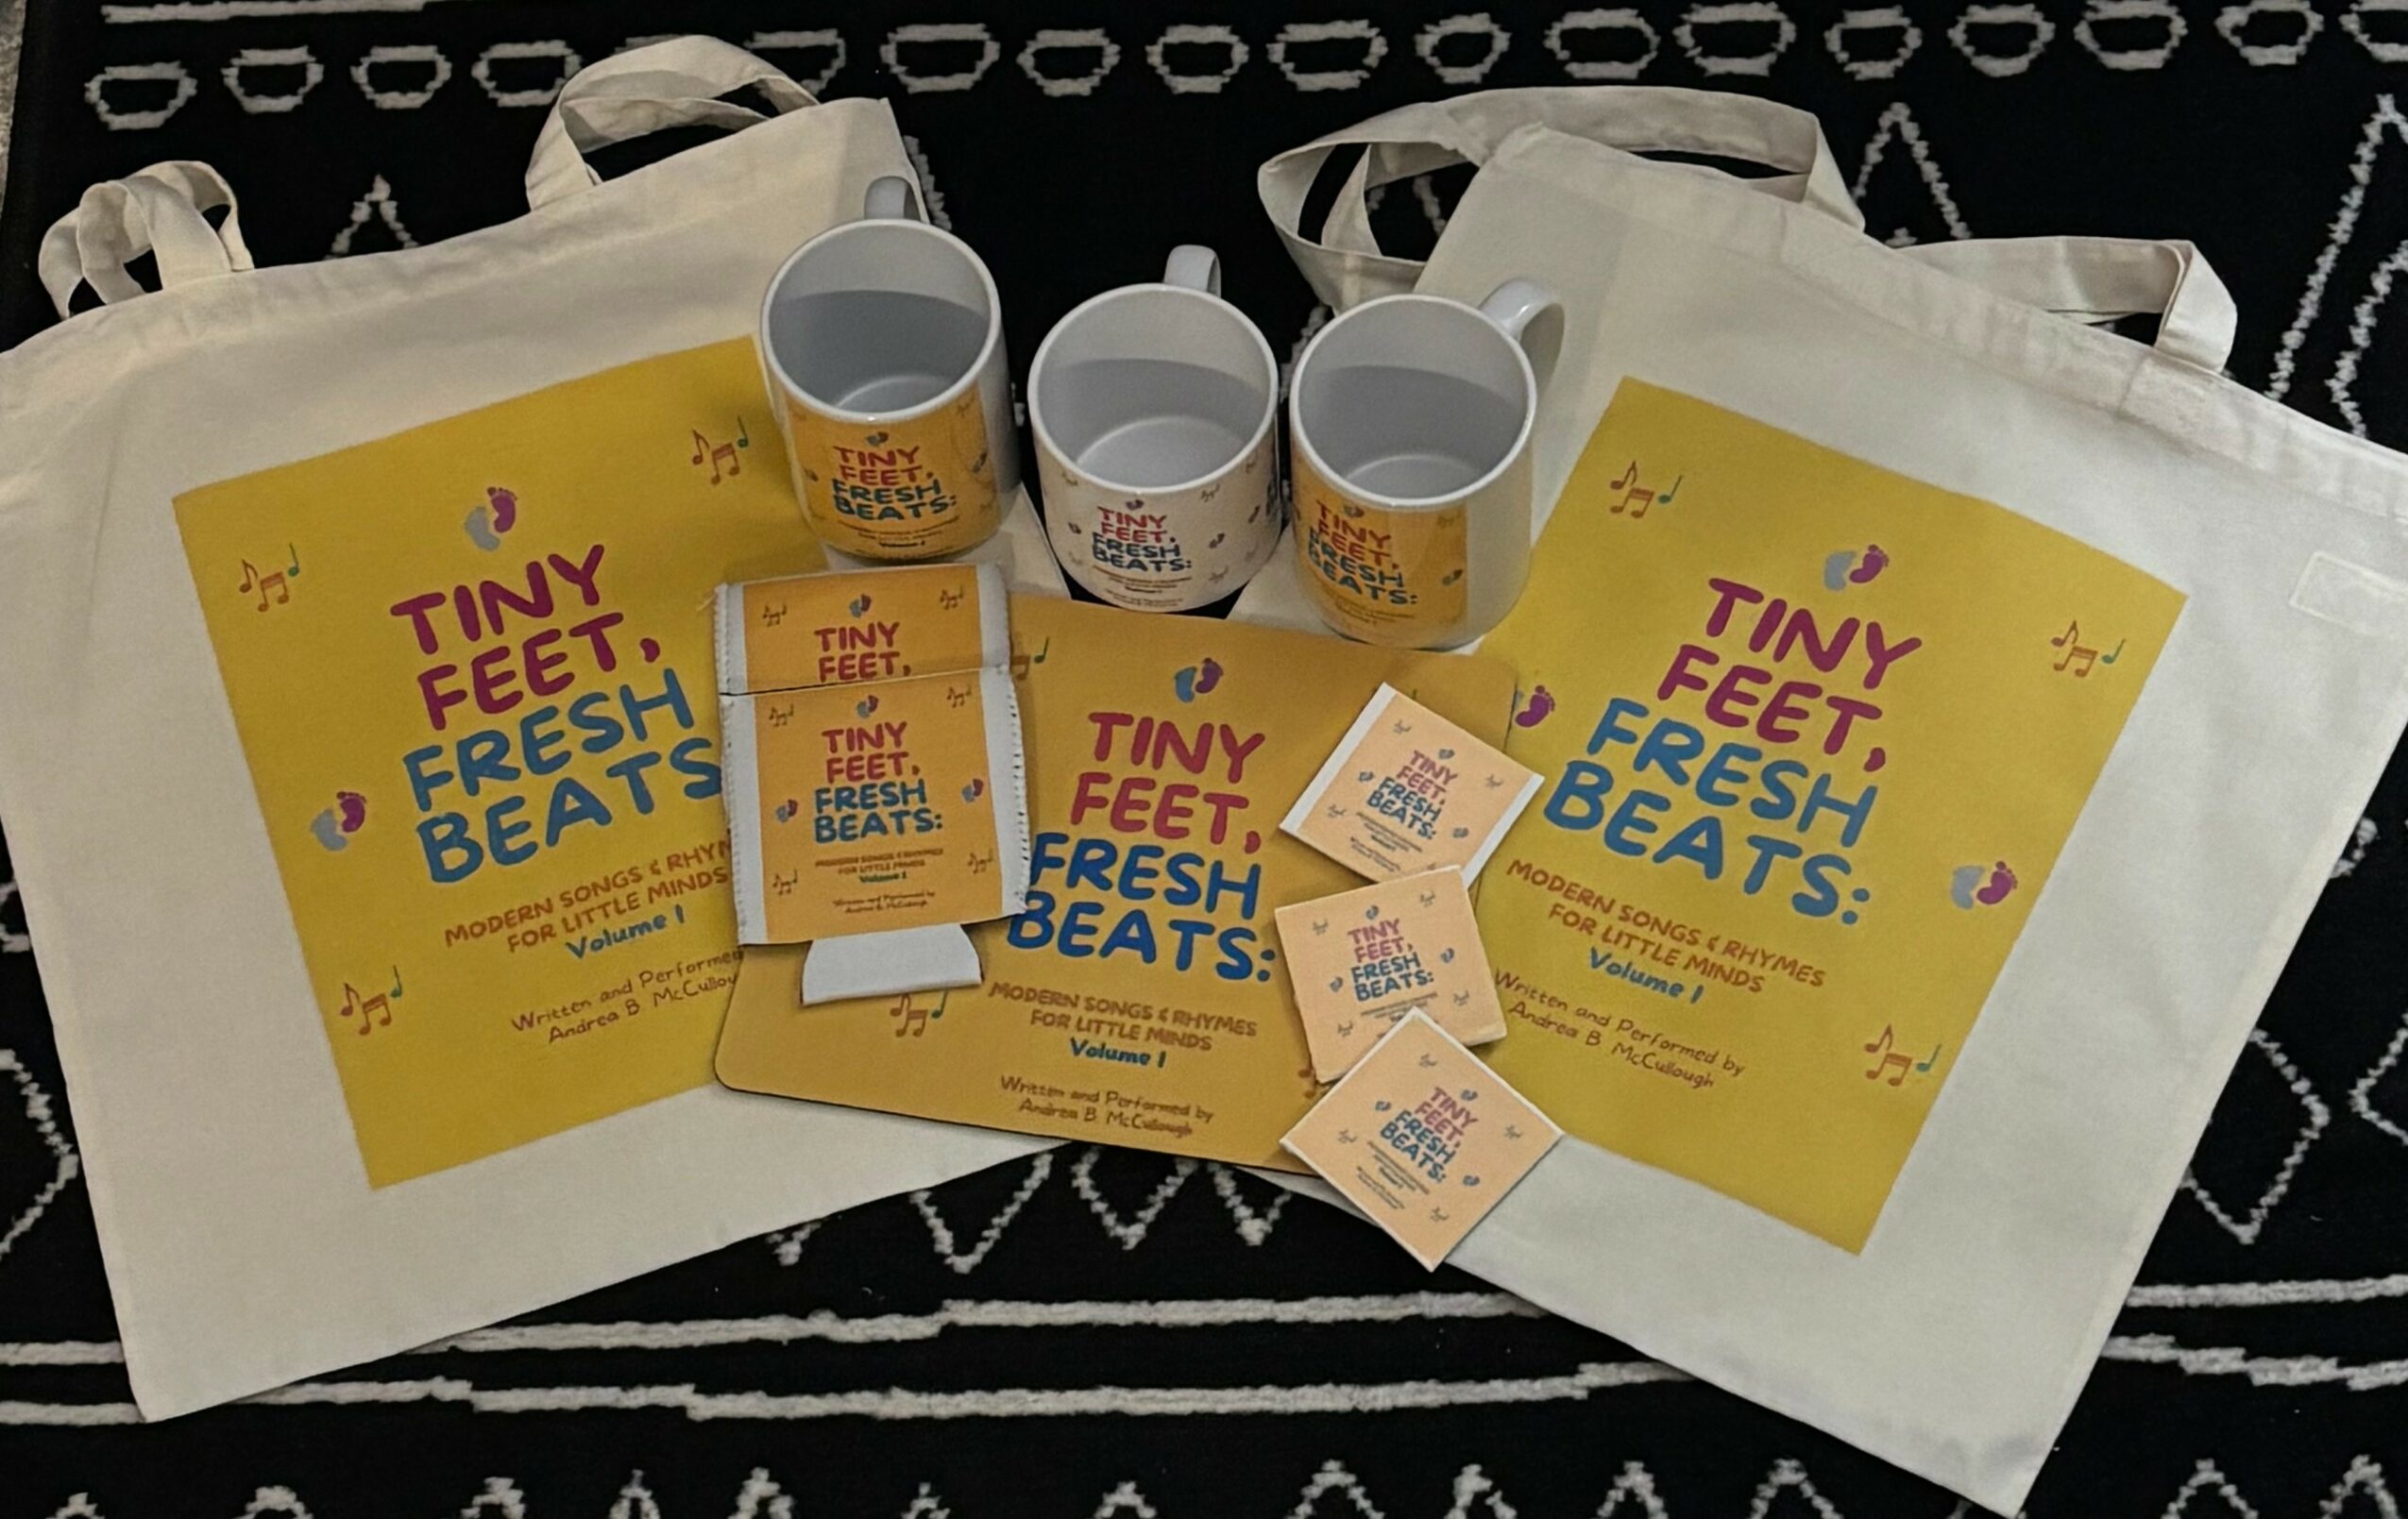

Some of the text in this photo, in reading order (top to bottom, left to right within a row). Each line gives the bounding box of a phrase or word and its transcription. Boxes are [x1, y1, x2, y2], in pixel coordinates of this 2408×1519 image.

[833, 445, 920, 466] TINY
[832, 477, 941, 504] FRESH
[832, 495, 957, 520] BEATS:
[1097, 506, 1167, 529] TINY
[1316, 500, 1392, 549] TINY
[1093, 532, 1180, 558] FRESH
[1093, 545, 1192, 572] BEATS:
[1308, 526, 1404, 588] FRESH
[1308, 543, 1417, 605] BEATS:
[389, 544, 605, 655] TINY
[813, 621, 901, 652] TINY
[1704, 577, 1923, 690] TINY
[416, 612, 661, 731] FEET,
[818, 650, 912, 683] FEET,
[1656, 644, 1887, 773] FEET,
[402, 667, 695, 812] FRESH
[821, 721, 907, 753] TINY
[1088, 712, 1266, 785] TINY
[825, 751, 921, 785] FEET,
[1409, 750, 1459, 785] TINY
[1586, 697, 1879, 849] FRESH
[814, 778, 927, 815] FRESH
[1069, 771, 1262, 854] FEET,
[1366, 789, 1438, 840] BEATS:
[1378, 776, 1442, 822] FRESH
[814, 807, 943, 844] BEATS:
[1542, 759, 1871, 925] BEATS:
[1029, 832, 1262, 921] FRESH
[444, 897, 554, 947] MODERN
[559, 866, 643, 909] SONGS
[648, 859, 662, 876] &
[506, 866, 729, 954] FOR LITTLE MINDS
[1505, 858, 1827, 987] MODERN SONGS & RHYMES
[565, 913, 668, 960] Volume
[1007, 890, 1275, 983] BEATS:
[1347, 918, 1400, 945] TINY
[1353, 937, 1414, 964] FEET,
[1548, 902, 1767, 994] FOR LITTLE MINDS
[1350, 951, 1421, 984] FRESH
[1354, 969, 1434, 1003] BEATS:
[1589, 946, 1685, 999] Volume
[511, 999, 592, 1033] Written
[600, 978, 634, 1002] and
[548, 1010, 619, 1044] Andrea
[625, 998, 640, 1017] B
[988, 981, 1080, 1009] MODERN
[1083, 996, 1154, 1021] SONGS
[1172, 1007, 1259, 1038] RHYMES
[1030, 1008, 1213, 1052] FOR LITTLE MINDS
[1495, 966, 1746, 1078] Written and Performed by
[1069, 1037, 1152, 1067] Volume
[1507, 1001, 1716, 1090] Andrea B McCullough
[1000, 1074, 1214, 1124] Written and Performed by
[1083, 1106, 1097, 1122] B
[1431, 1087, 1479, 1129] TINY
[1379, 1121, 1447, 1184] BEATS:
[1395, 1109, 1456, 1164] FRESH
